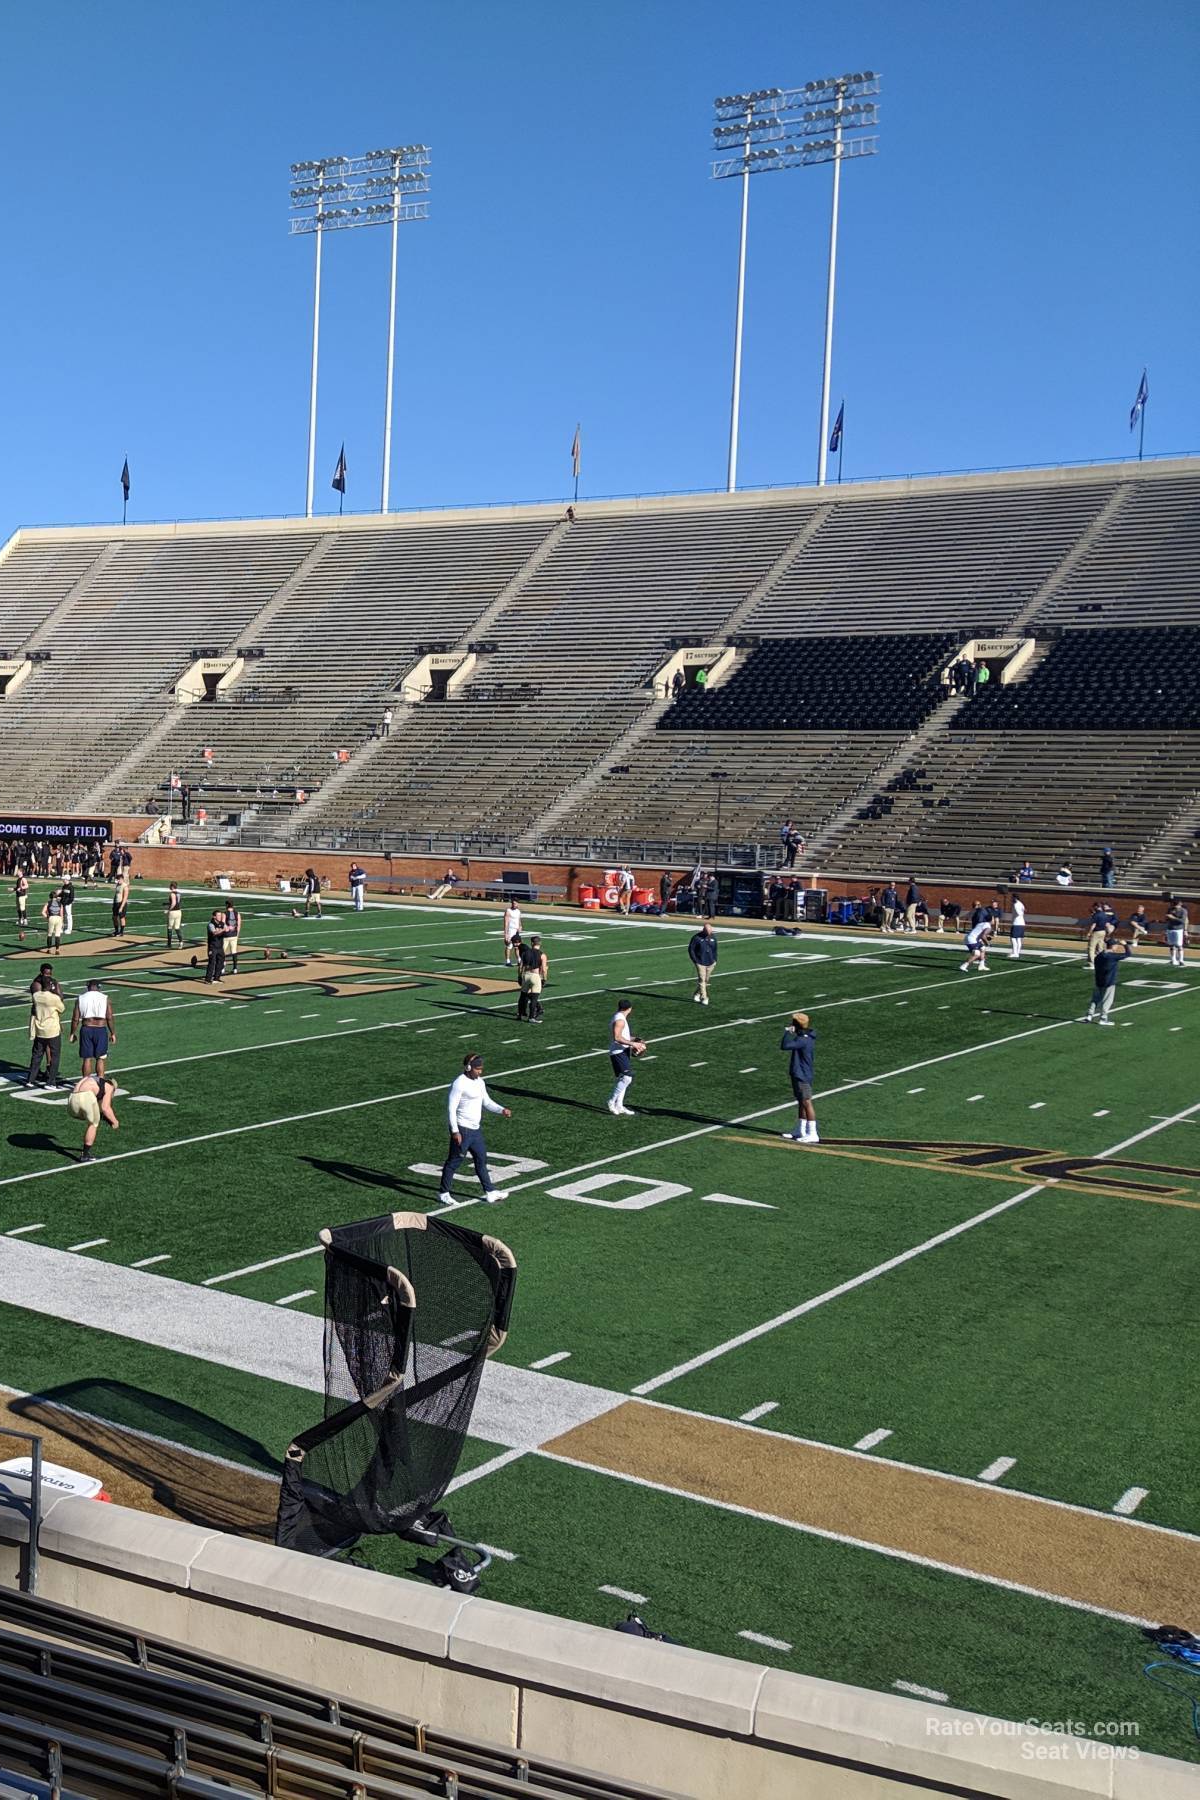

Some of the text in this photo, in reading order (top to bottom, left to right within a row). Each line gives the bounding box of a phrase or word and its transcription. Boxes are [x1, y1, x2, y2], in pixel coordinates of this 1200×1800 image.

[29, 825, 44, 835] TO
[45, 825, 71, 836] BB&T
[74, 826, 107, 837] FIELD
